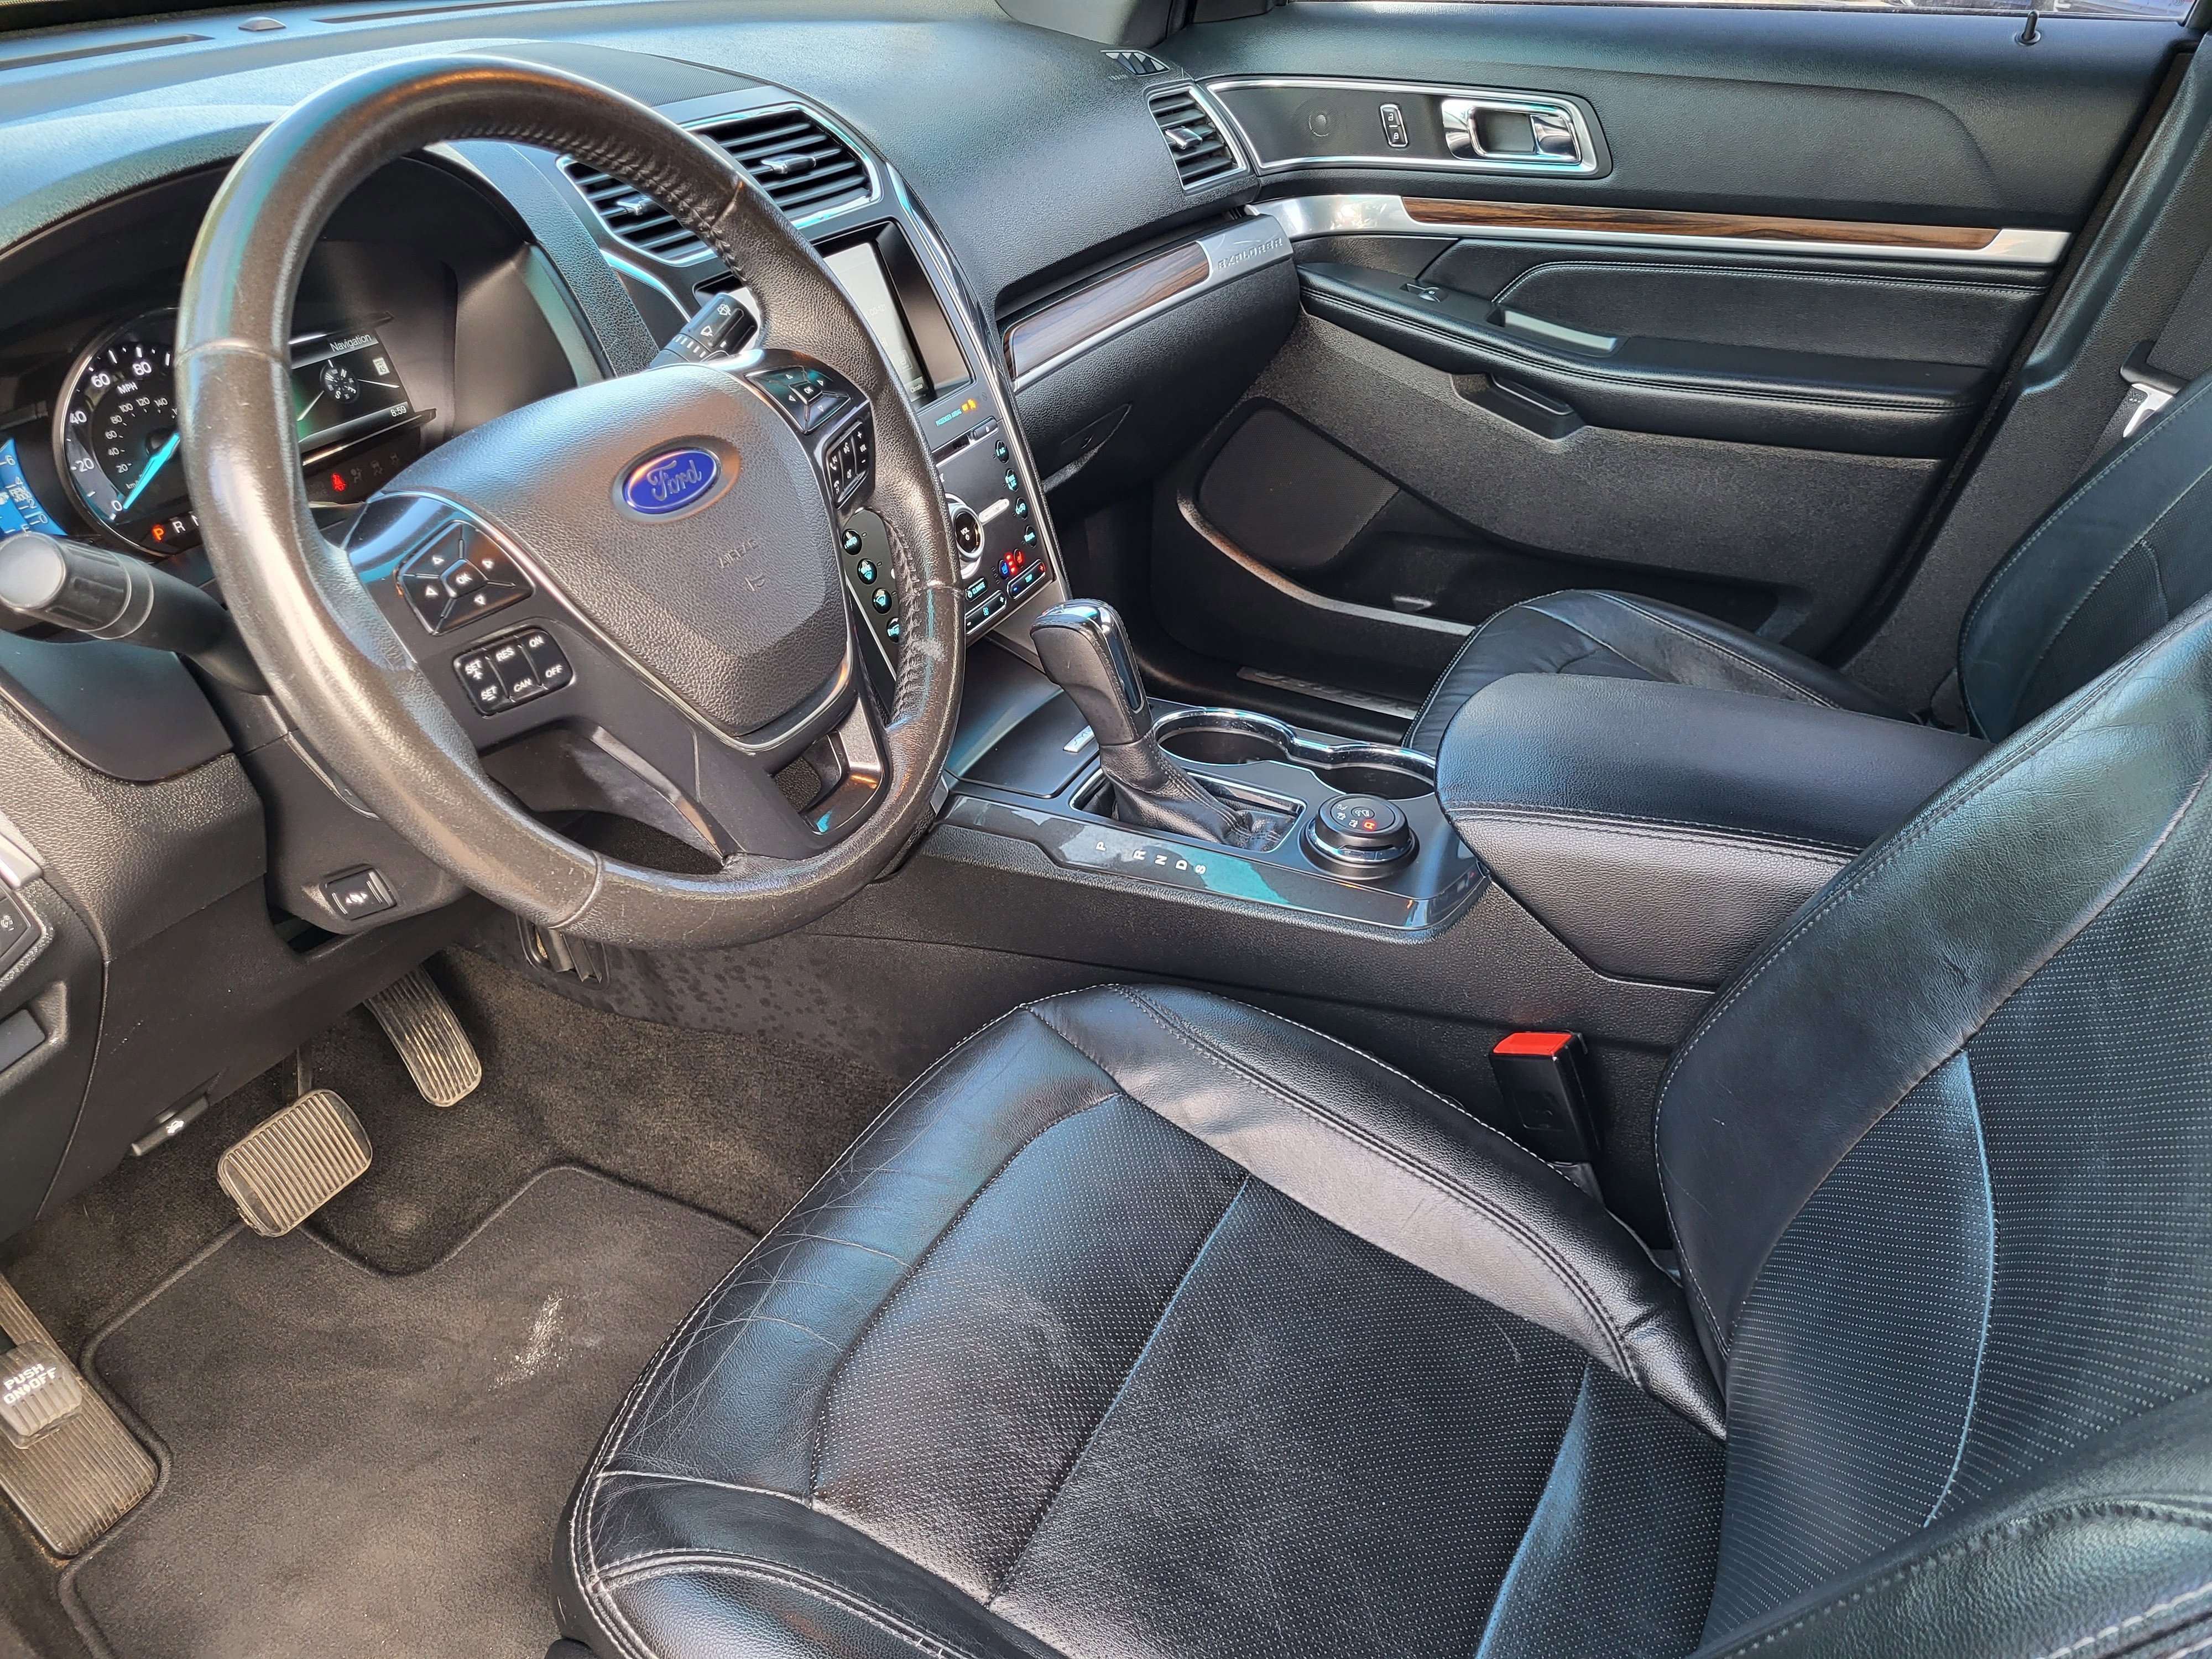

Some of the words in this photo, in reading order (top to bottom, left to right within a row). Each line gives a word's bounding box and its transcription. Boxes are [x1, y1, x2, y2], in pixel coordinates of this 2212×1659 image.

[330, 334, 372, 352] Navigation
[133, 361, 152, 375] 80
[91, 373, 111, 388] 60
[117, 382, 138, 394] MPH
[135, 397, 150, 406] 120
[154, 398, 168, 408] 140
[118, 403, 133, 413] 100
[390, 405, 407, 417] 8:59
[69, 410, 87, 424] 40
[110, 415, 123, 424] 80
[105, 430, 117, 440] 60
[108, 447, 119, 456] 40
[5, 455, 15, 465] 6
[75, 458, 95, 472] 20
[116, 463, 129, 473] 20
[15, 477, 24, 486] 4
[646, 460, 702, 502] Ford
[29, 498, 38, 509] 2
[111, 500, 123, 512] 0
[40, 514, 48, 524] 0
[152, 526, 165, 541] P
[172, 521, 186, 534] R
[456, 572, 473, 584] OK
[529, 635, 545, 648] ON
[495, 647, 515, 662] RES
[465, 659, 482, 675] SET
[545, 664, 563, 678] OFF
[514, 678, 533, 692] CAN
[481, 685, 498, 700] SET
[1095, 841, 1106, 851] P
[1133, 849, 1146, 860] R
[1155, 854, 1167, 865] N
[1175, 859, 1188, 871] D
[1195, 864, 1206, 874] S
[4, 1363, 45, 1390] PUSH
